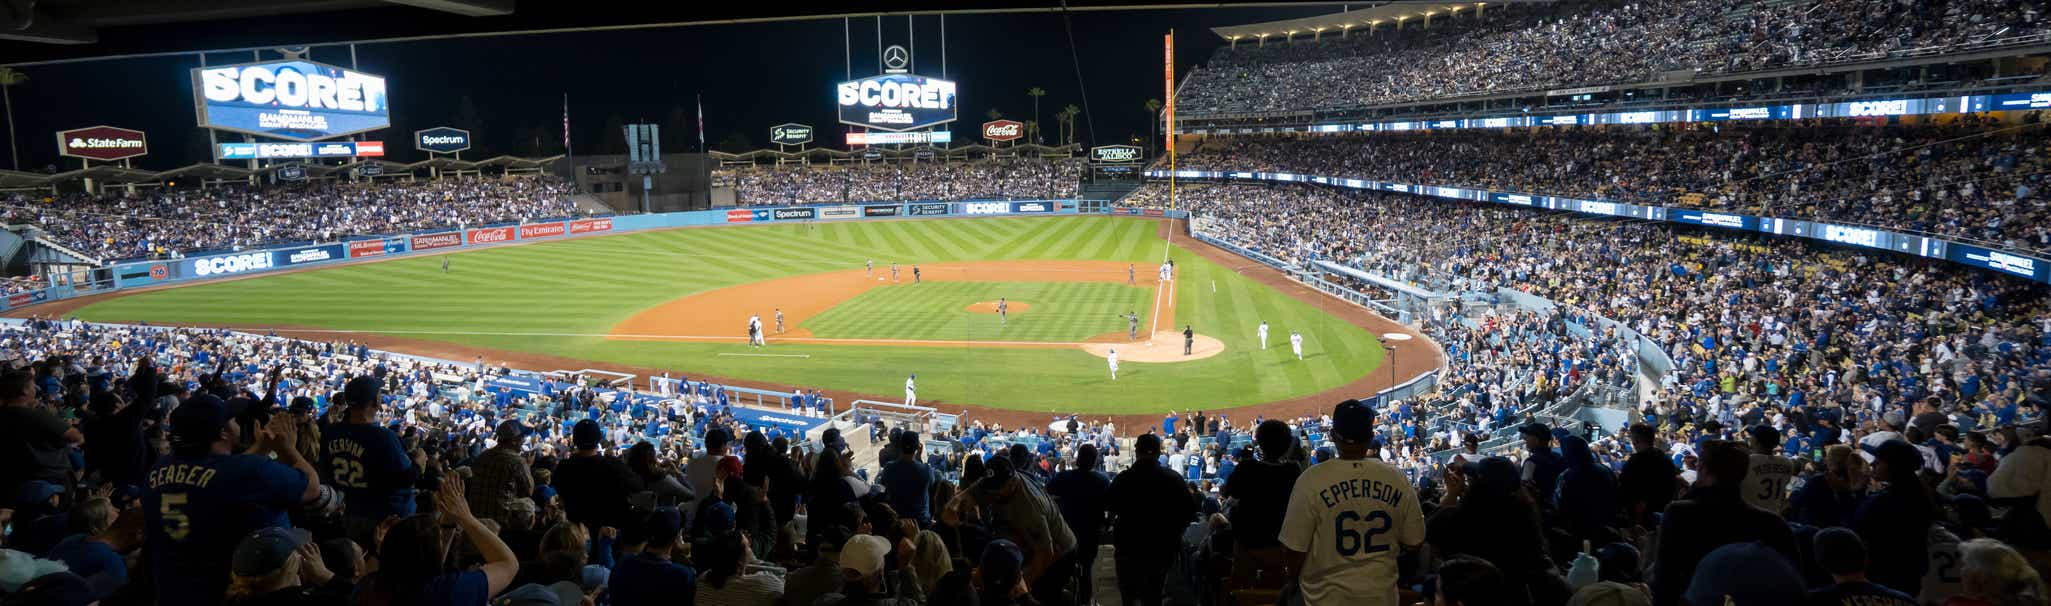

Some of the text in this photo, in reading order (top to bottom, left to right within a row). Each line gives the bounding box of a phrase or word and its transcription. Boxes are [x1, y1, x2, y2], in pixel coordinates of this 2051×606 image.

[202, 66, 385, 112] SCORE!
[838, 79, 956, 109] SCORE!
[423, 135, 464, 146] Spectrum
[987, 125, 1019, 137] Coca-Cola
[1101, 152, 1133, 160] JALISCO
[775, 209, 811, 219] Spectrum
[473, 228, 507, 243] Coca-Cola
[521, 227, 533, 236] Fly
[534, 224, 564, 234] Emirates
[1826, 225, 1877, 247] SCORE!
[194, 251, 273, 276] SCORE!
[150, 464, 216, 488] SEAGER
[332, 457, 368, 488] 22
[1320, 479, 1403, 508] EPPERSON
[1758, 478, 1782, 500] 31
[160, 493, 190, 541] 5
[1335, 510, 1391, 556] 62
